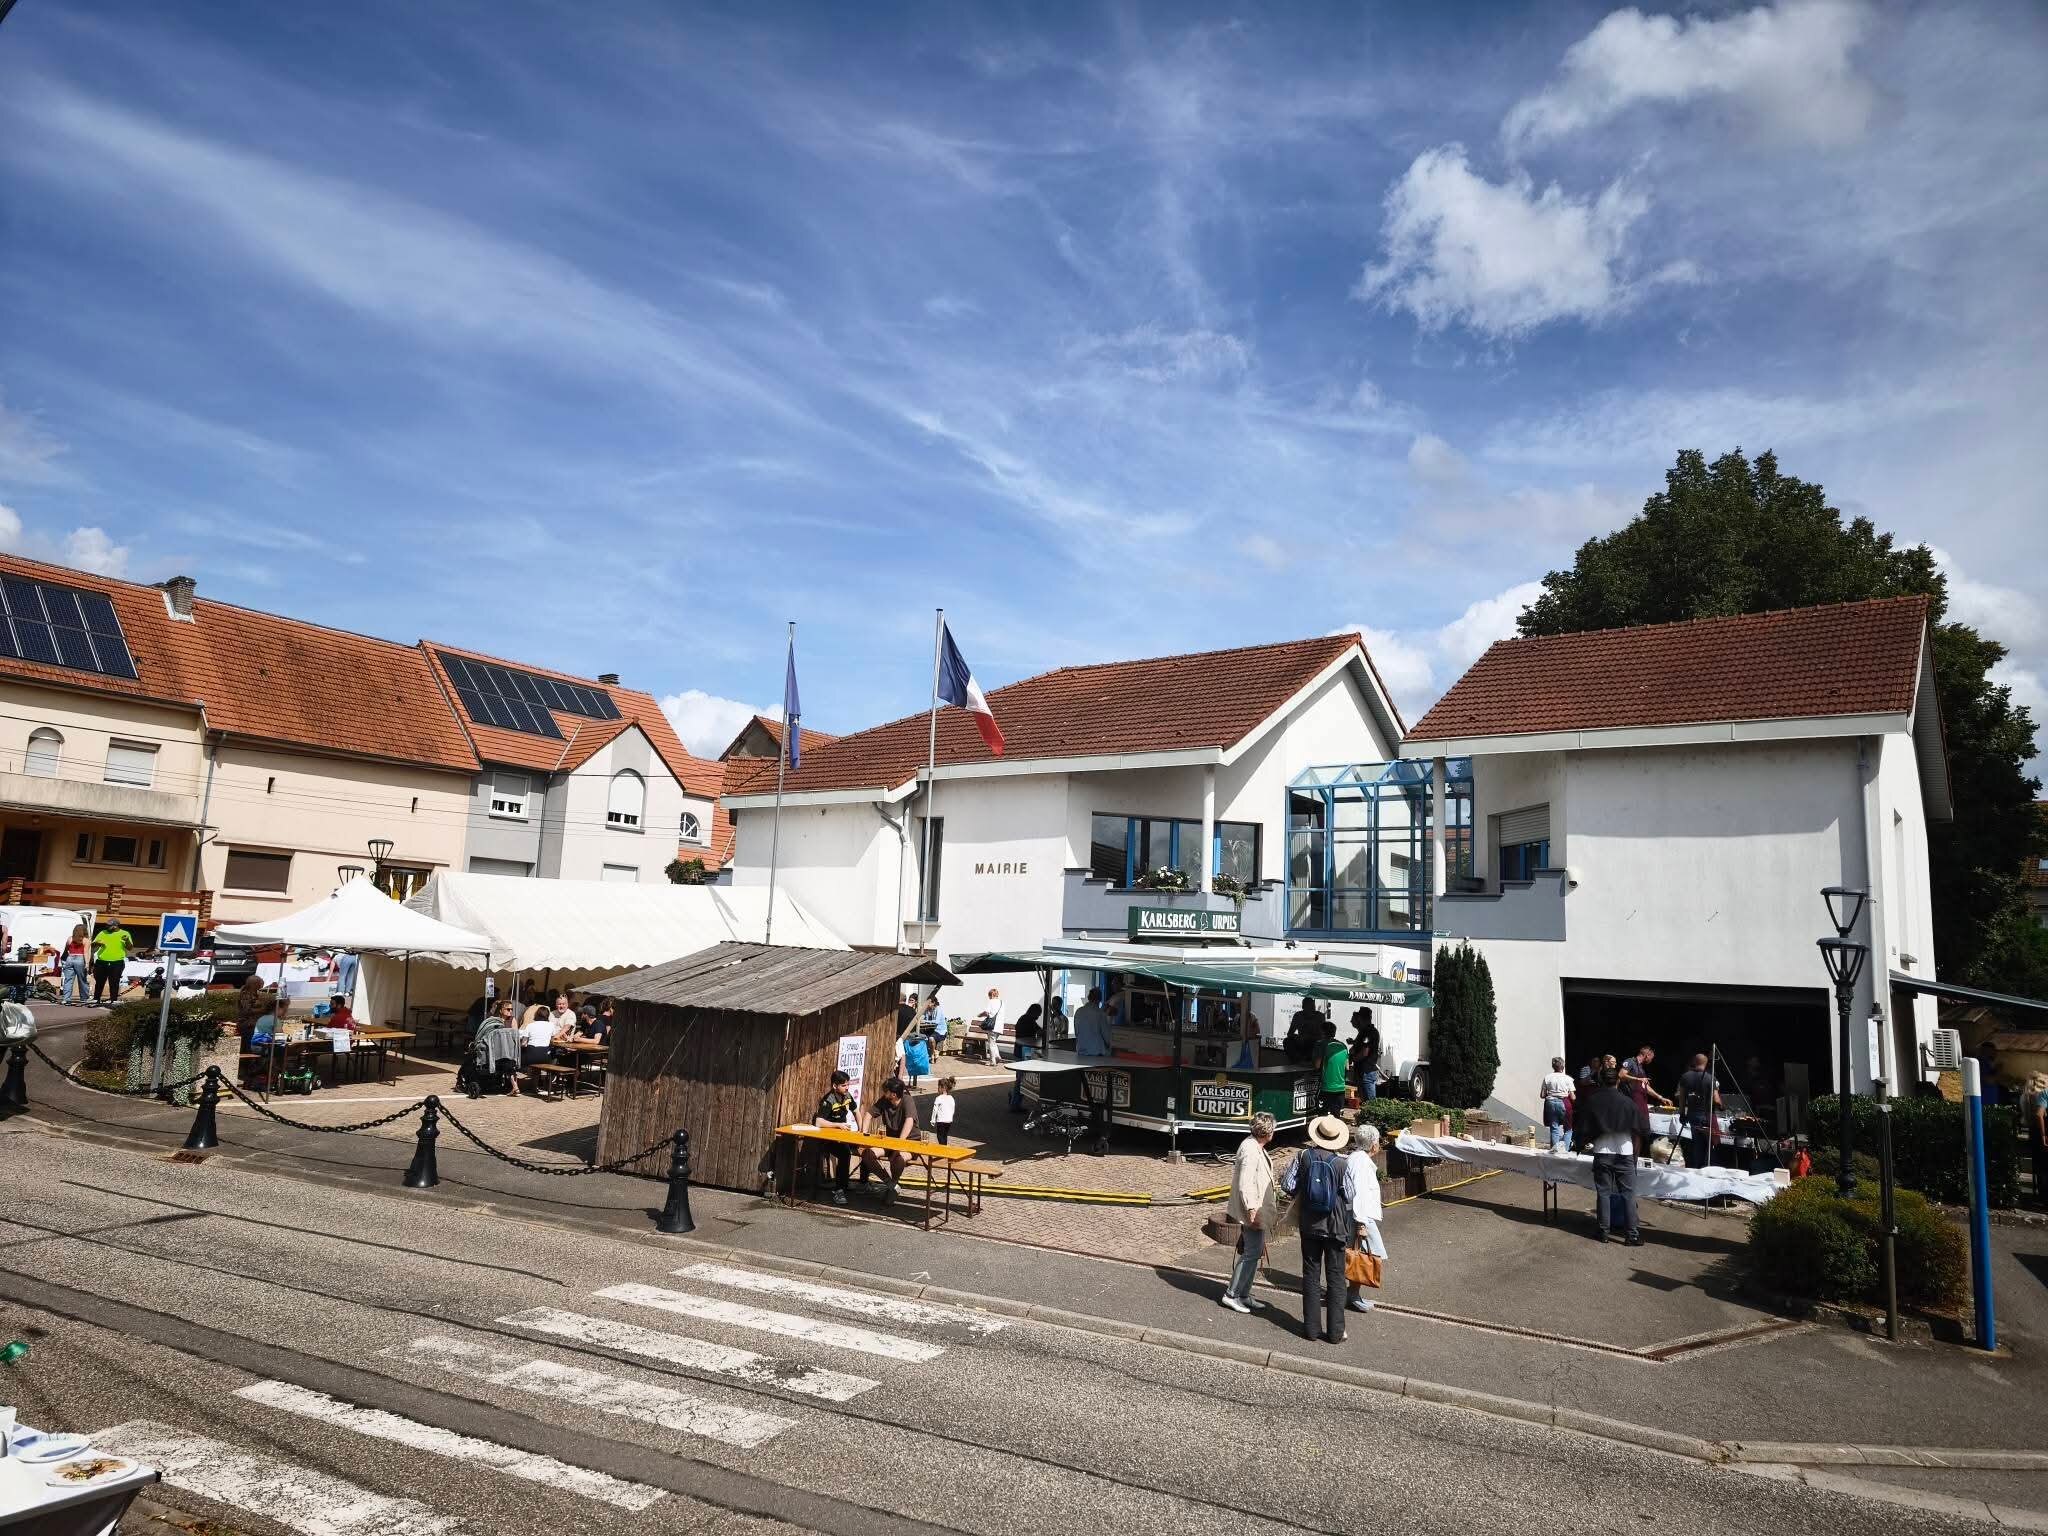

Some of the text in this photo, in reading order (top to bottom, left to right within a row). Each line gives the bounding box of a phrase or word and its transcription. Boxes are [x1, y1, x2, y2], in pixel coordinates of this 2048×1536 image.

[975, 862, 1028, 875] MAIRIE
[1141, 910, 1238, 930] KARLSBERG URPILS
[840, 1053, 864, 1068] GLITTER
[1194, 1086, 1249, 1099] KARLSBERG
[1197, 1099, 1245, 1116] URPILS
